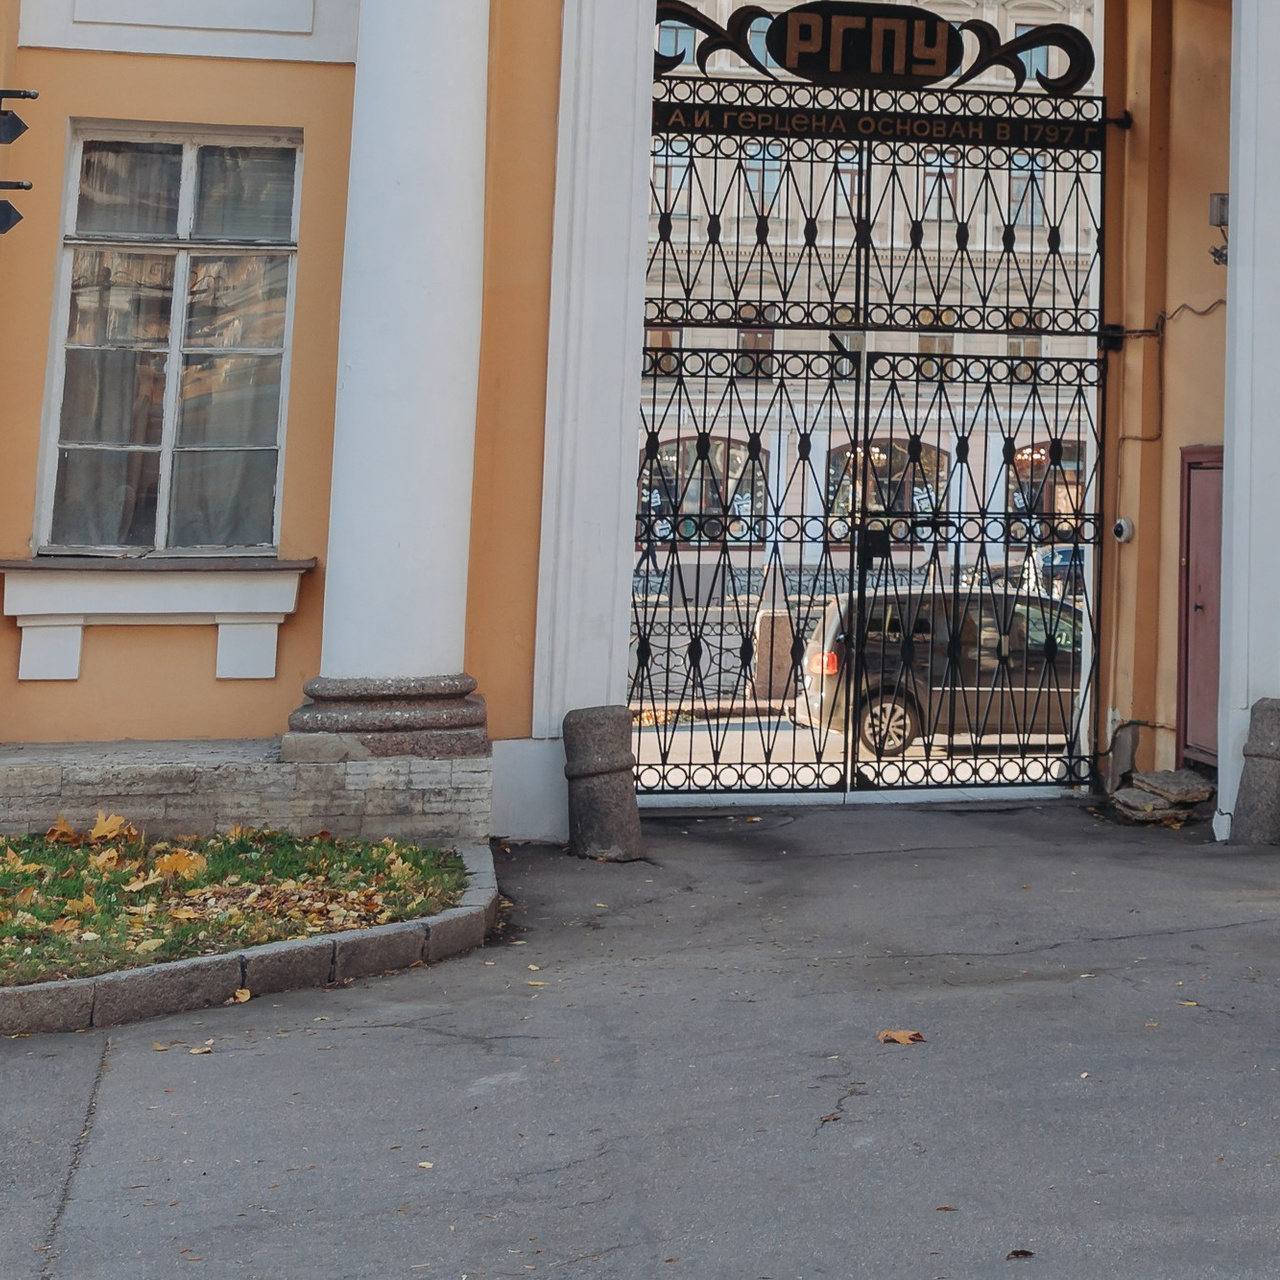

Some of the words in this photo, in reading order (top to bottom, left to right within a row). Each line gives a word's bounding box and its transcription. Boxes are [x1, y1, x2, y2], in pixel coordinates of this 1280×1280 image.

[786, 11, 949, 77] РГПУ
[857, 116, 984, 140] ОСНОВАН
[996, 122, 1012, 141] В
[1023, 123, 1076, 144] 1797
